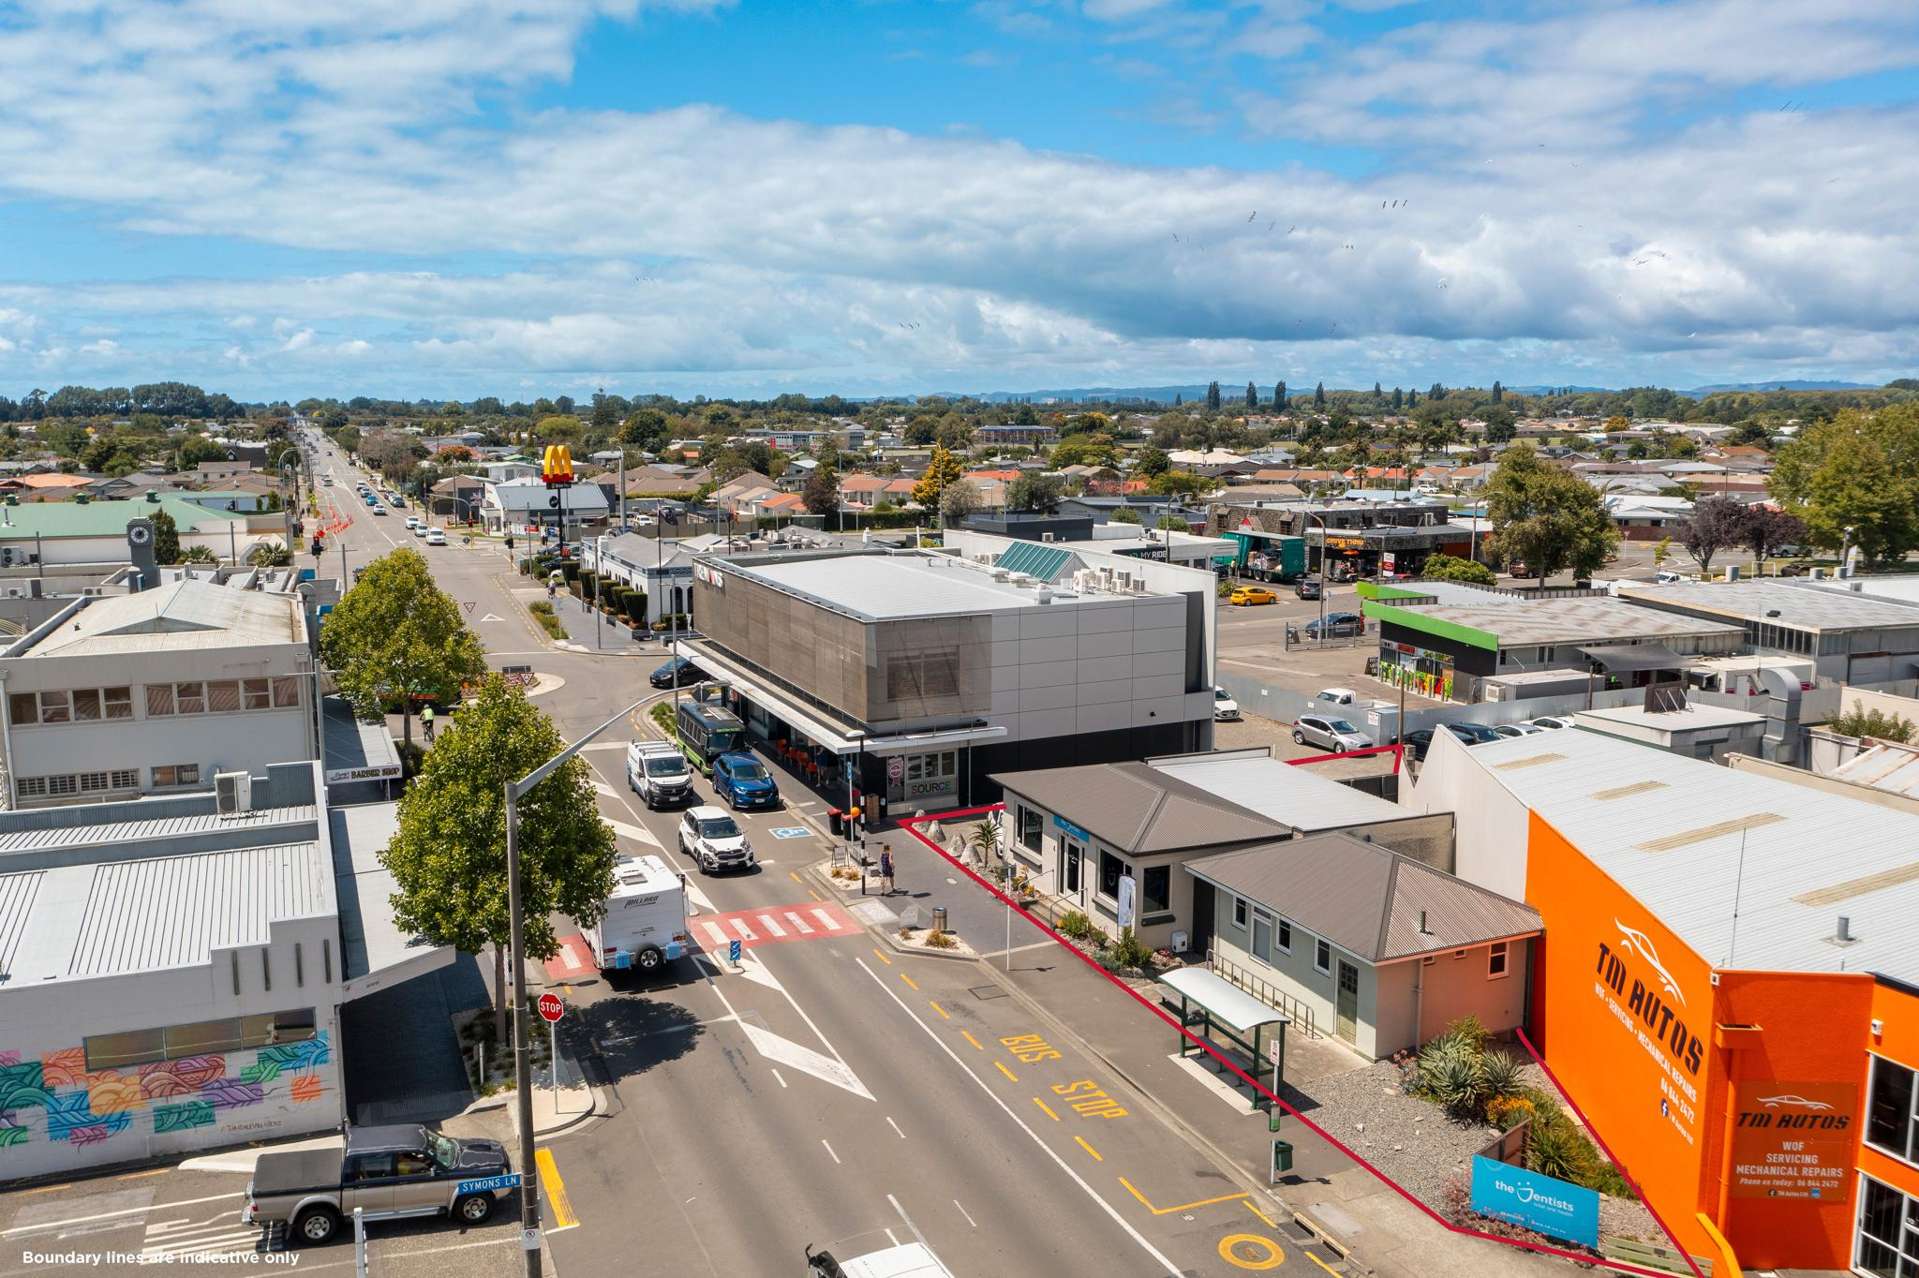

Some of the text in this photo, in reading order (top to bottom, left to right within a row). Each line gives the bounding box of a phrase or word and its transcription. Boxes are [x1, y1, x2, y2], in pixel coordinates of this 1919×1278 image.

[1140, 551, 1151, 559] MY
[1151, 550, 1167, 558] RIDE
[351, 768, 381, 779] BARBER
[381, 767, 400, 777] SHOP
[912, 782, 952, 795] SOURCE
[540, 1001, 561, 1013] STOP
[1596, 942, 1704, 1077] TM AUTOS
[1608, 997, 1634, 1034] SERVICING
[1637, 1028, 1671, 1076] MECHANICAL
[1671, 1065, 1697, 1104] REPAIRS
[1000, 1033, 1129, 1119] BUS STOP
[1737, 1112, 1850, 1129] TM AUTOS
[1782, 1141, 1805, 1151] WOF
[1766, 1153, 1818, 1164] SERVICING
[1736, 1165, 1844, 1178] MECHANICAL REPAIRS
[462, 1176, 518, 1193] SYMONS LN
[1495, 1180, 1515, 1194] the
[1739, 1177, 1761, 1185] Phone
